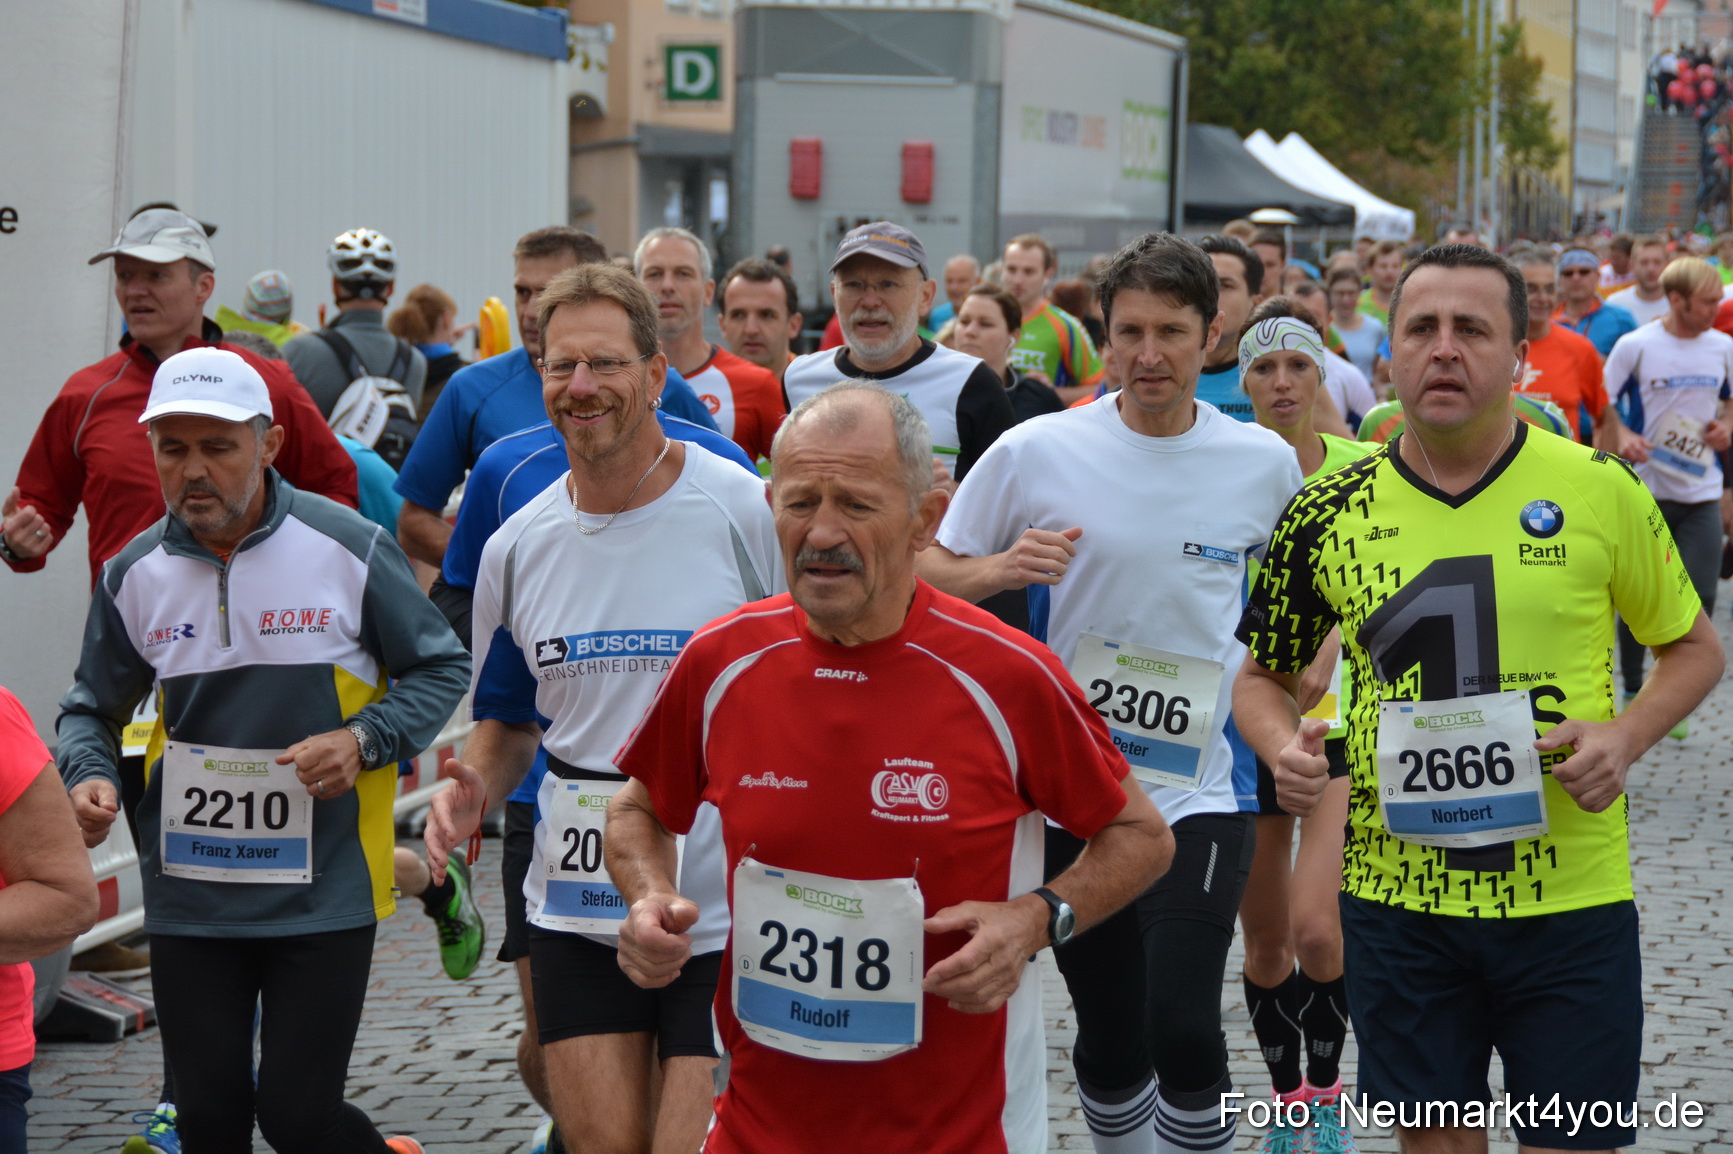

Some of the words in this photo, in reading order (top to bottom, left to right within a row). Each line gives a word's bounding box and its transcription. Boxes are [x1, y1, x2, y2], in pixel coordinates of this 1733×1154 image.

[672, 50, 715, 97] D
[0, 207, 18, 234] e
[173, 374, 223, 385] OLYMP
[1664, 430, 1706, 459] 2427
[1523, 500, 1561, 514] BMW
[1518, 543, 1567, 558] Partl
[1519, 557, 1567, 567] Neumarkt
[259, 608, 333, 629] ROWE
[259, 626, 305, 636] MOTOR
[308, 625, 327, 633] OIL
[145, 639, 171, 648] ACING
[576, 634, 684, 655] BÜSCHEL
[539, 658, 672, 684] FEINSCHNEIDTEA
[814, 667, 857, 680] CRAFT
[1130, 656, 1179, 676] BOCK
[1463, 675, 1486, 687] DER
[1488, 672, 1517, 684] NEUE
[1519, 671, 1542, 682] BMW
[1089, 678, 1191, 735] 2306
[1428, 709, 1485, 728] BOCK
[1113, 736, 1149, 757] Peter
[218, 760, 269, 774] BOCK
[884, 757, 934, 769] Laufteam
[1399, 741, 1515, 792] 2666
[890, 772, 920, 795] ASV
[184, 787, 289, 830] 2210
[590, 795, 613, 807] BO
[888, 795, 918, 804] NEUMARKT
[871, 808, 910, 822] Kraftsport
[921, 813, 949, 822] Fitness
[1431, 805, 1493, 824] Norbert
[192, 841, 231, 859] Franz
[236, 844, 280, 859] Xaver
[560, 827, 602, 873] 20
[581, 890, 623, 907] Stefan
[803, 886, 864, 914] BOCK
[760, 920, 891, 991] 2318
[790, 1000, 850, 1028] Rudolf
